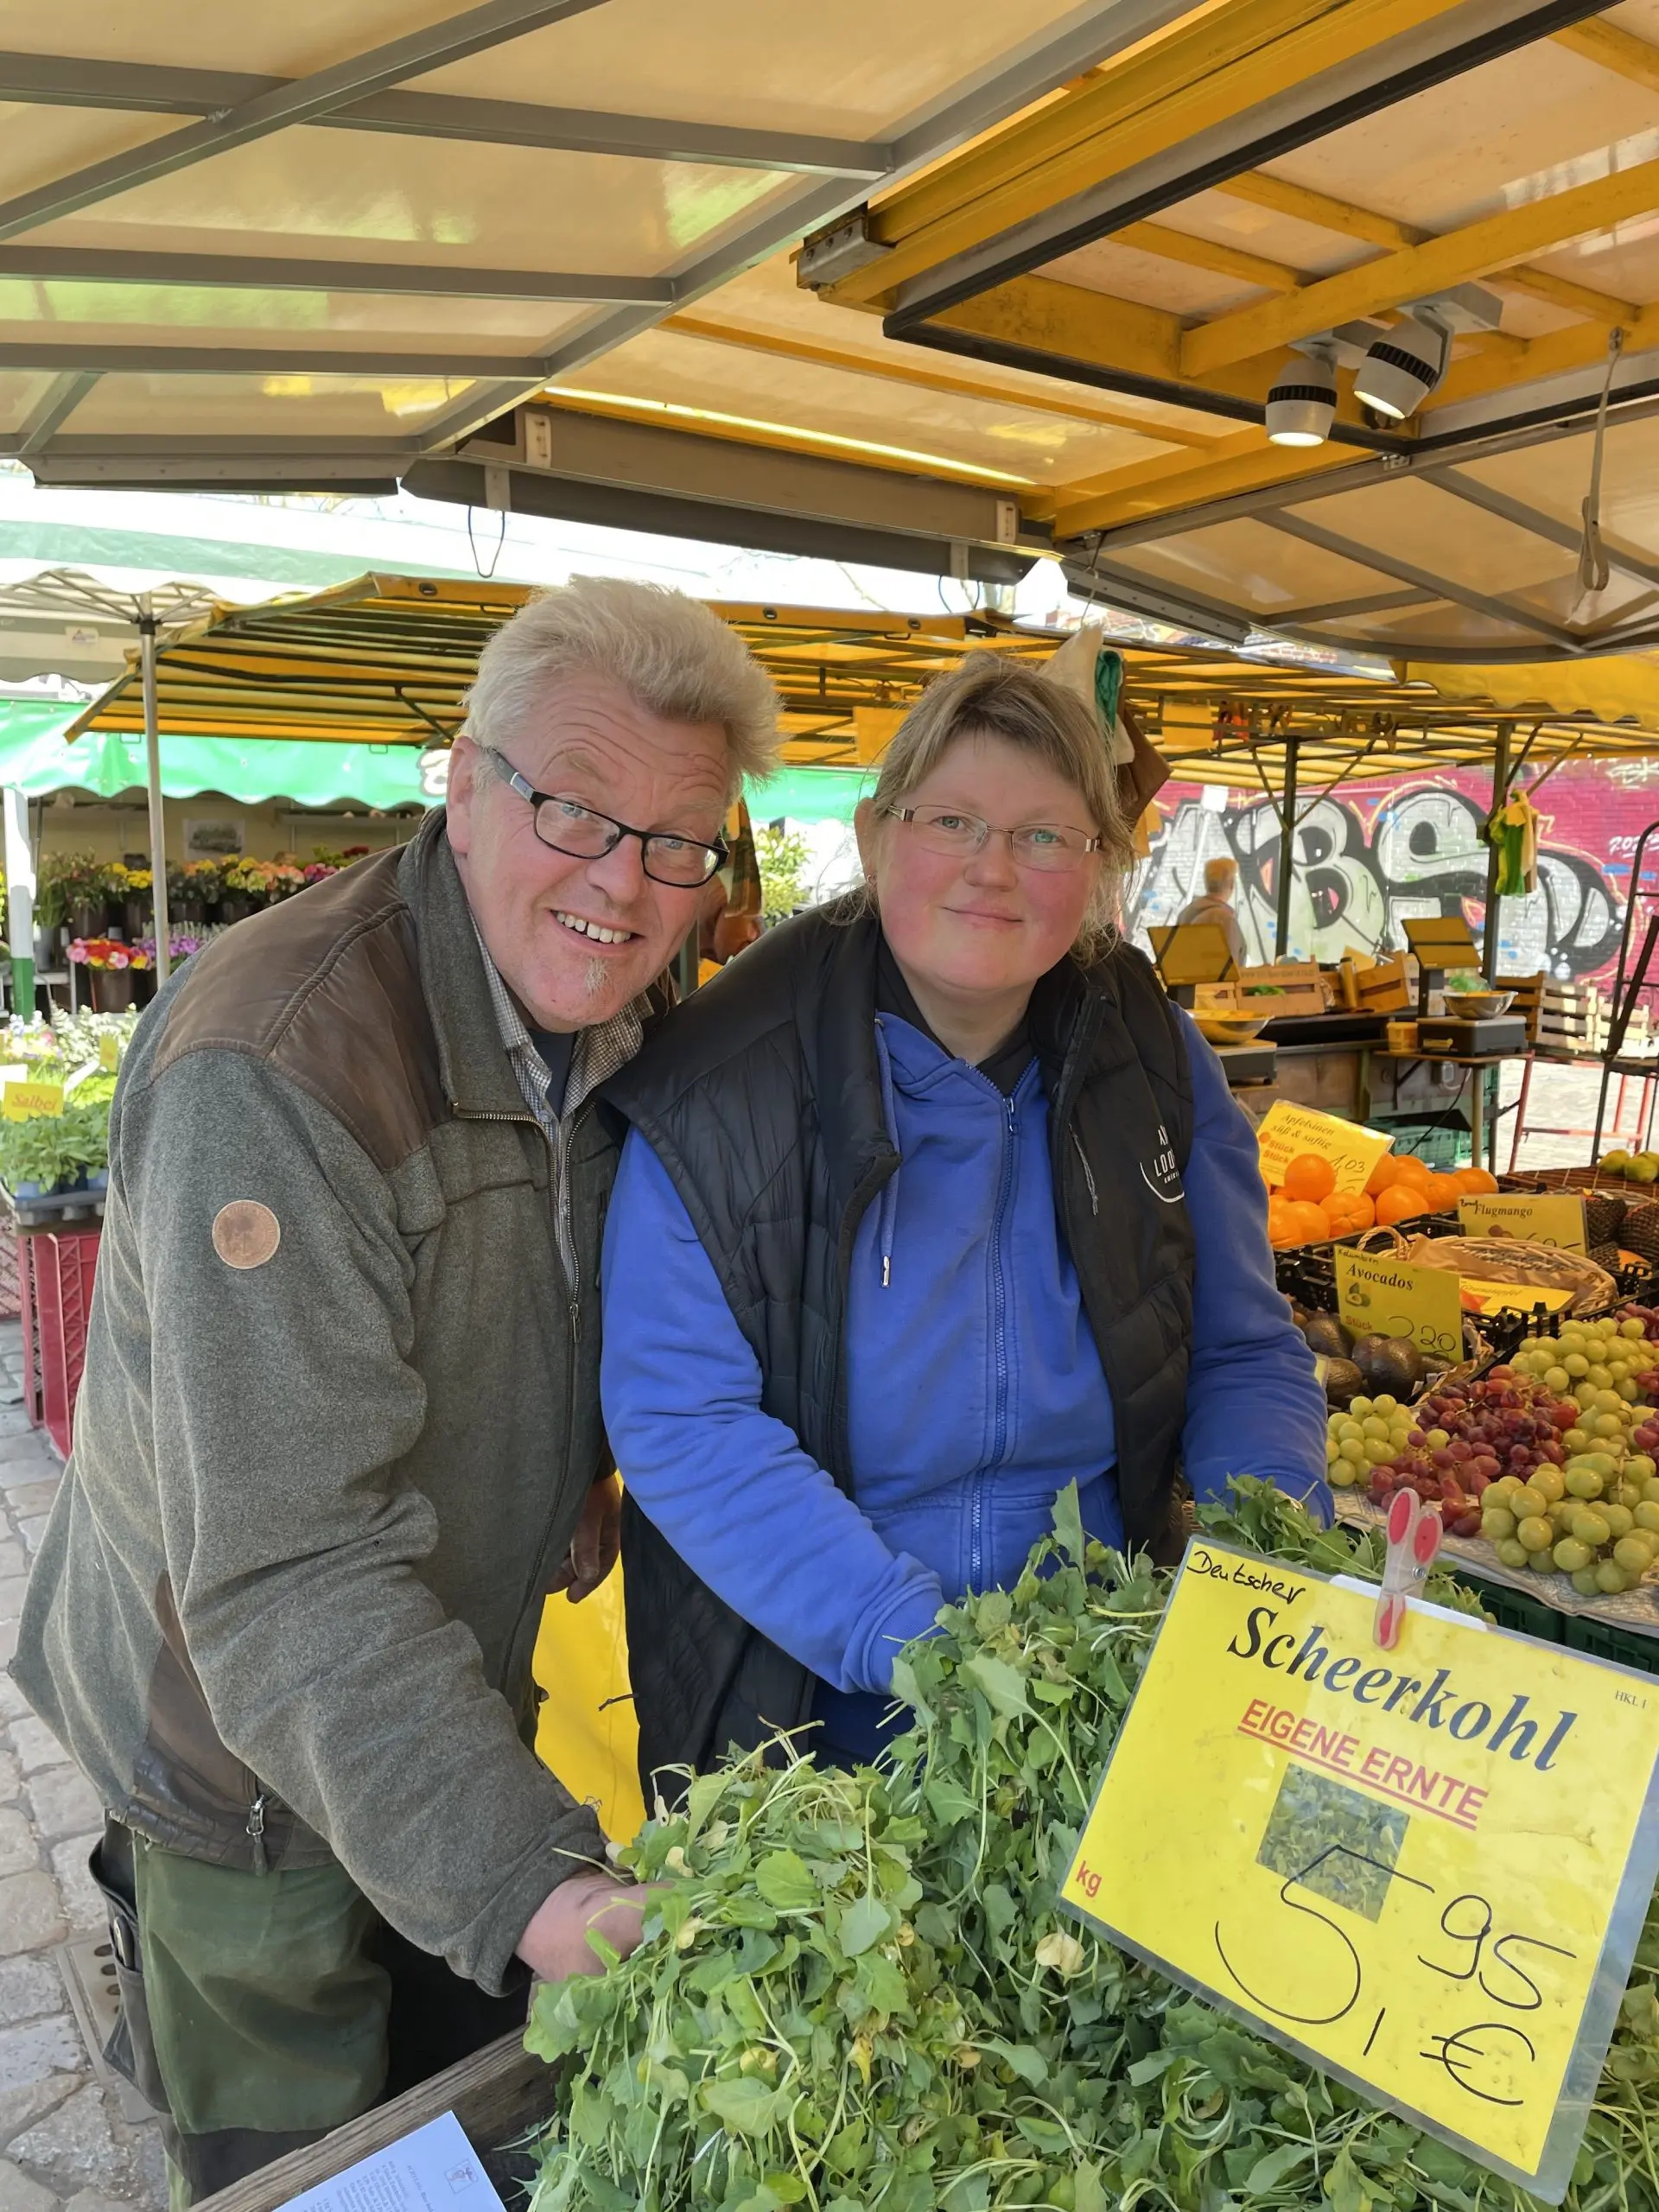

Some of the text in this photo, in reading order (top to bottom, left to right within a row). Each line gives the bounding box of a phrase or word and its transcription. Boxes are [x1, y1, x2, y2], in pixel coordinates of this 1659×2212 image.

[1281, 1114, 1336, 1135] Apfelsinen
[1303, 1135, 1332, 1151] saftig
[1474, 1205, 1533, 1219] Flugmango
[1346, 1263, 1414, 1291] Avocados
[1345, 1315, 1373, 1332] Stück
[1186, 1550, 1306, 1605] Deutscher
[1227, 1606, 1578, 1771] Scheerkohl
[1614, 1690, 1638, 1707] HKL
[1240, 1699, 1490, 1821] EIGENE ERNTE
[1074, 1860, 1103, 1898] kg
[1420, 2023, 1535, 2105] €
